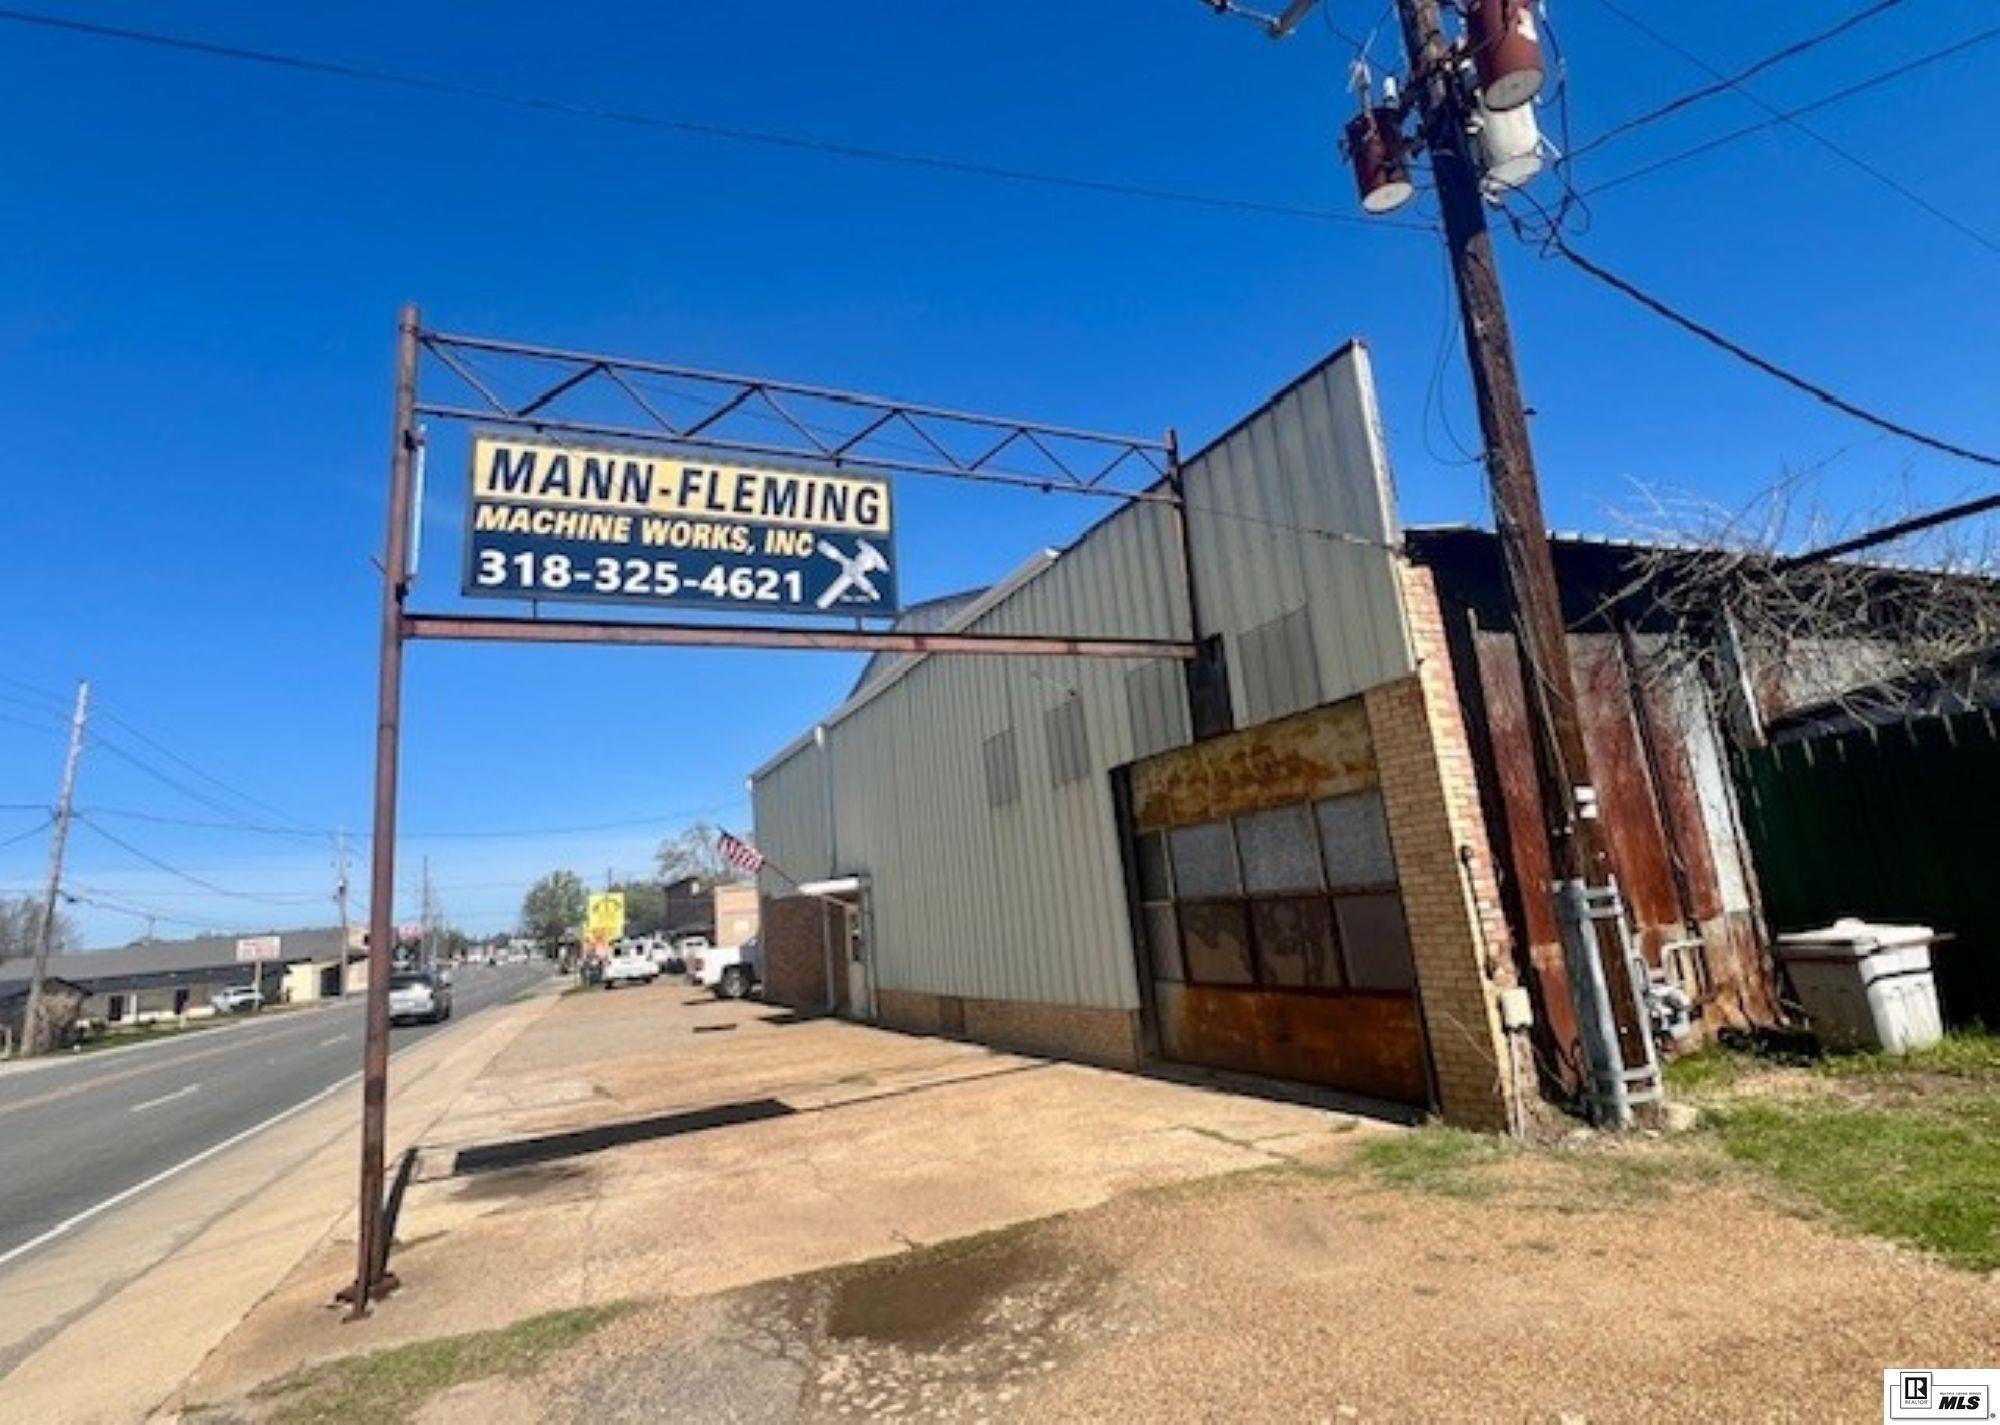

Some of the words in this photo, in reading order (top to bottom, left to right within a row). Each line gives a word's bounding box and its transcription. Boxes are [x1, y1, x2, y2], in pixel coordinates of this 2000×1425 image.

[488, 447, 880, 526] MANN-FLEMING
[474, 503, 630, 545] MACHINE
[641, 517, 755, 556] WORKS,
[764, 531, 815, 557] INC
[477, 549, 802, 602] 318-325-4621
